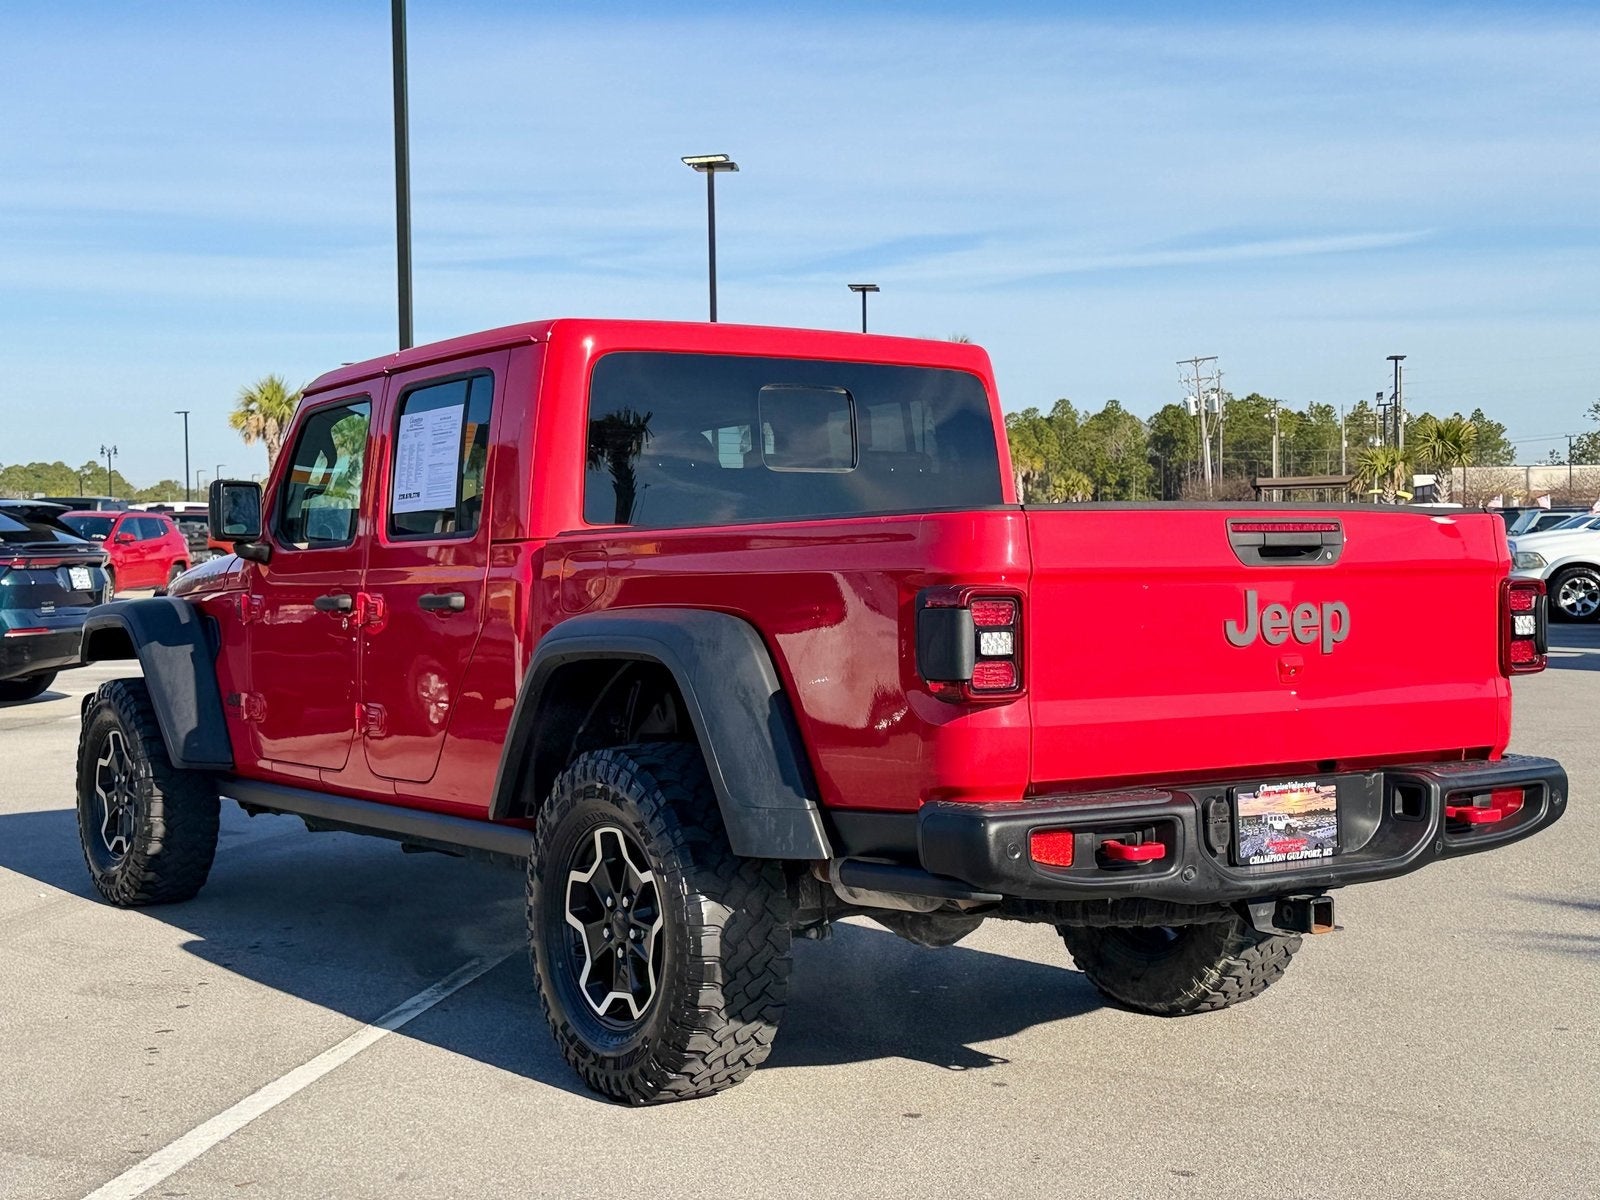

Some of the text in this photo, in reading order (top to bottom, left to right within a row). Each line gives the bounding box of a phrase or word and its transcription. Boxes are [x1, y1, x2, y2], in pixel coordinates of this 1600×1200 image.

[1224, 588, 1351, 655] Jeep
[1250, 853, 1286, 864] CHAMPION
[1323, 848, 1333, 856] MS
